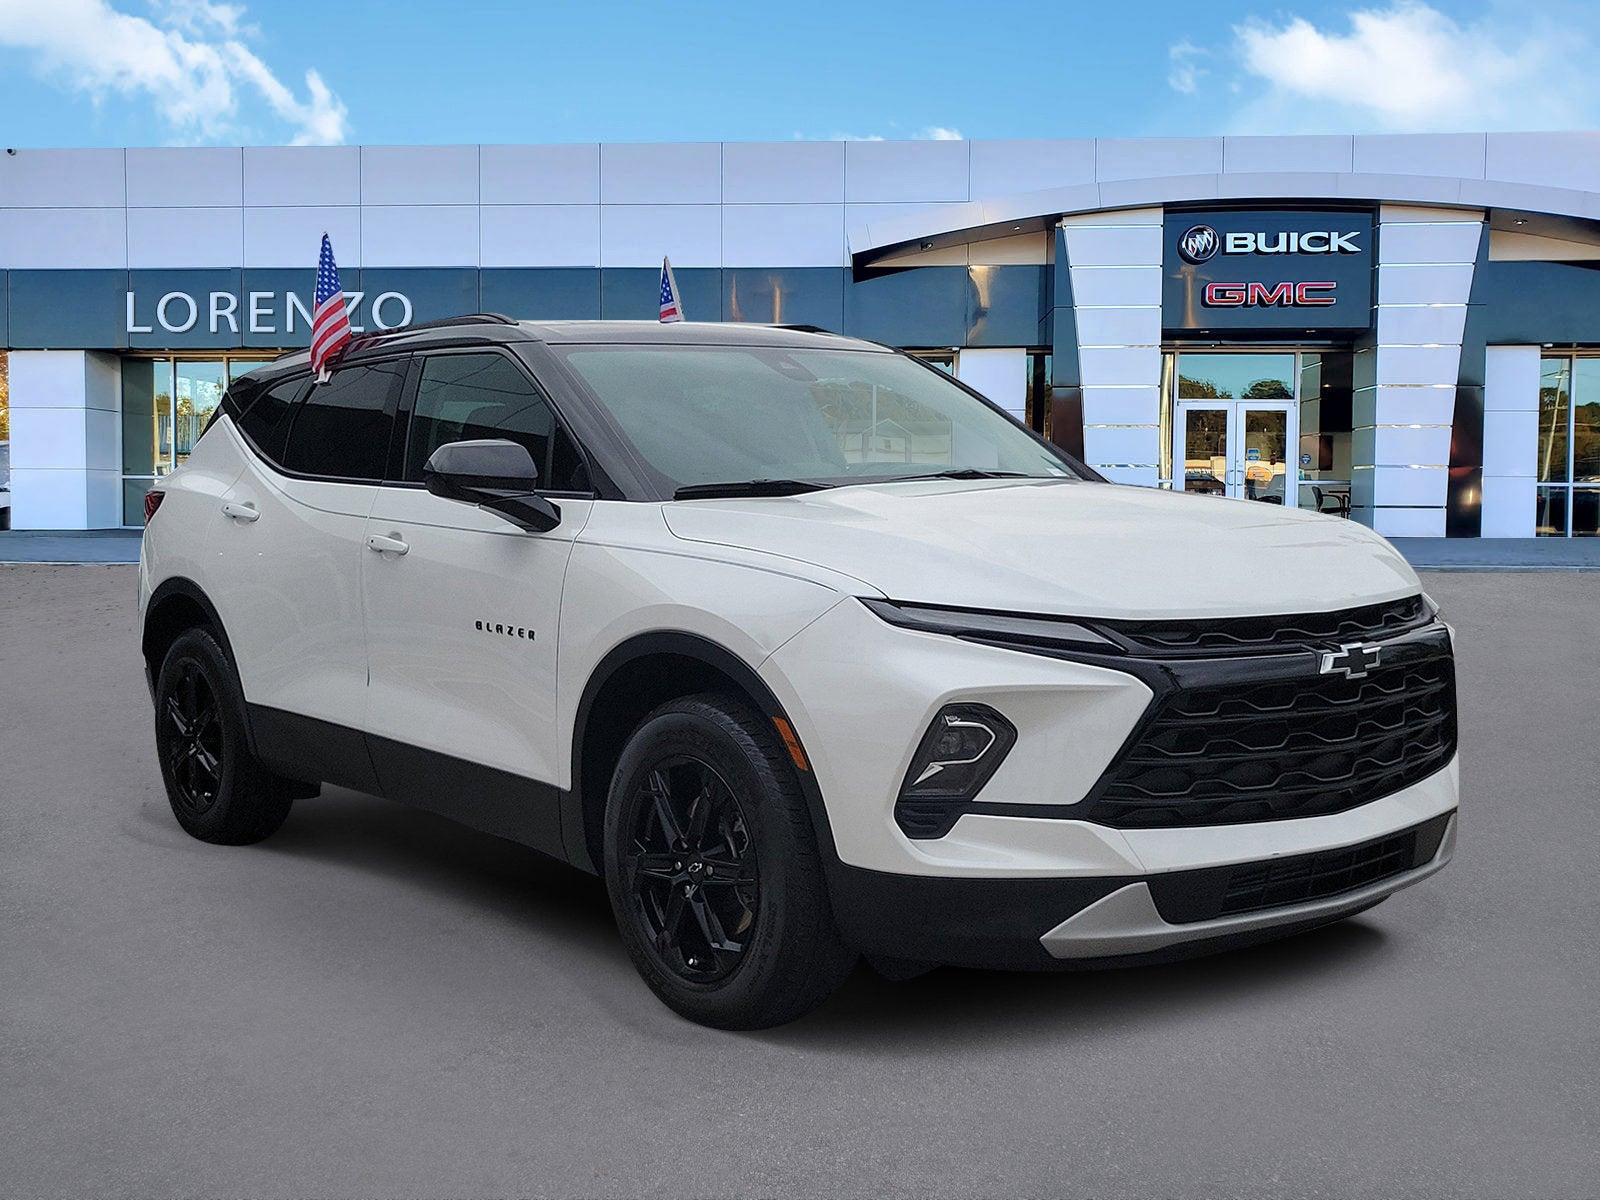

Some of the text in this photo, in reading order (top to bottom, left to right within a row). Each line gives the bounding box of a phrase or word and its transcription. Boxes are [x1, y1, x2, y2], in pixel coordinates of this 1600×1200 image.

[1226, 231, 1361, 253] BUICK
[1205, 281, 1337, 306] GMC
[126, 291, 413, 333] LORENZO
[475, 620, 536, 641] BLAZER
